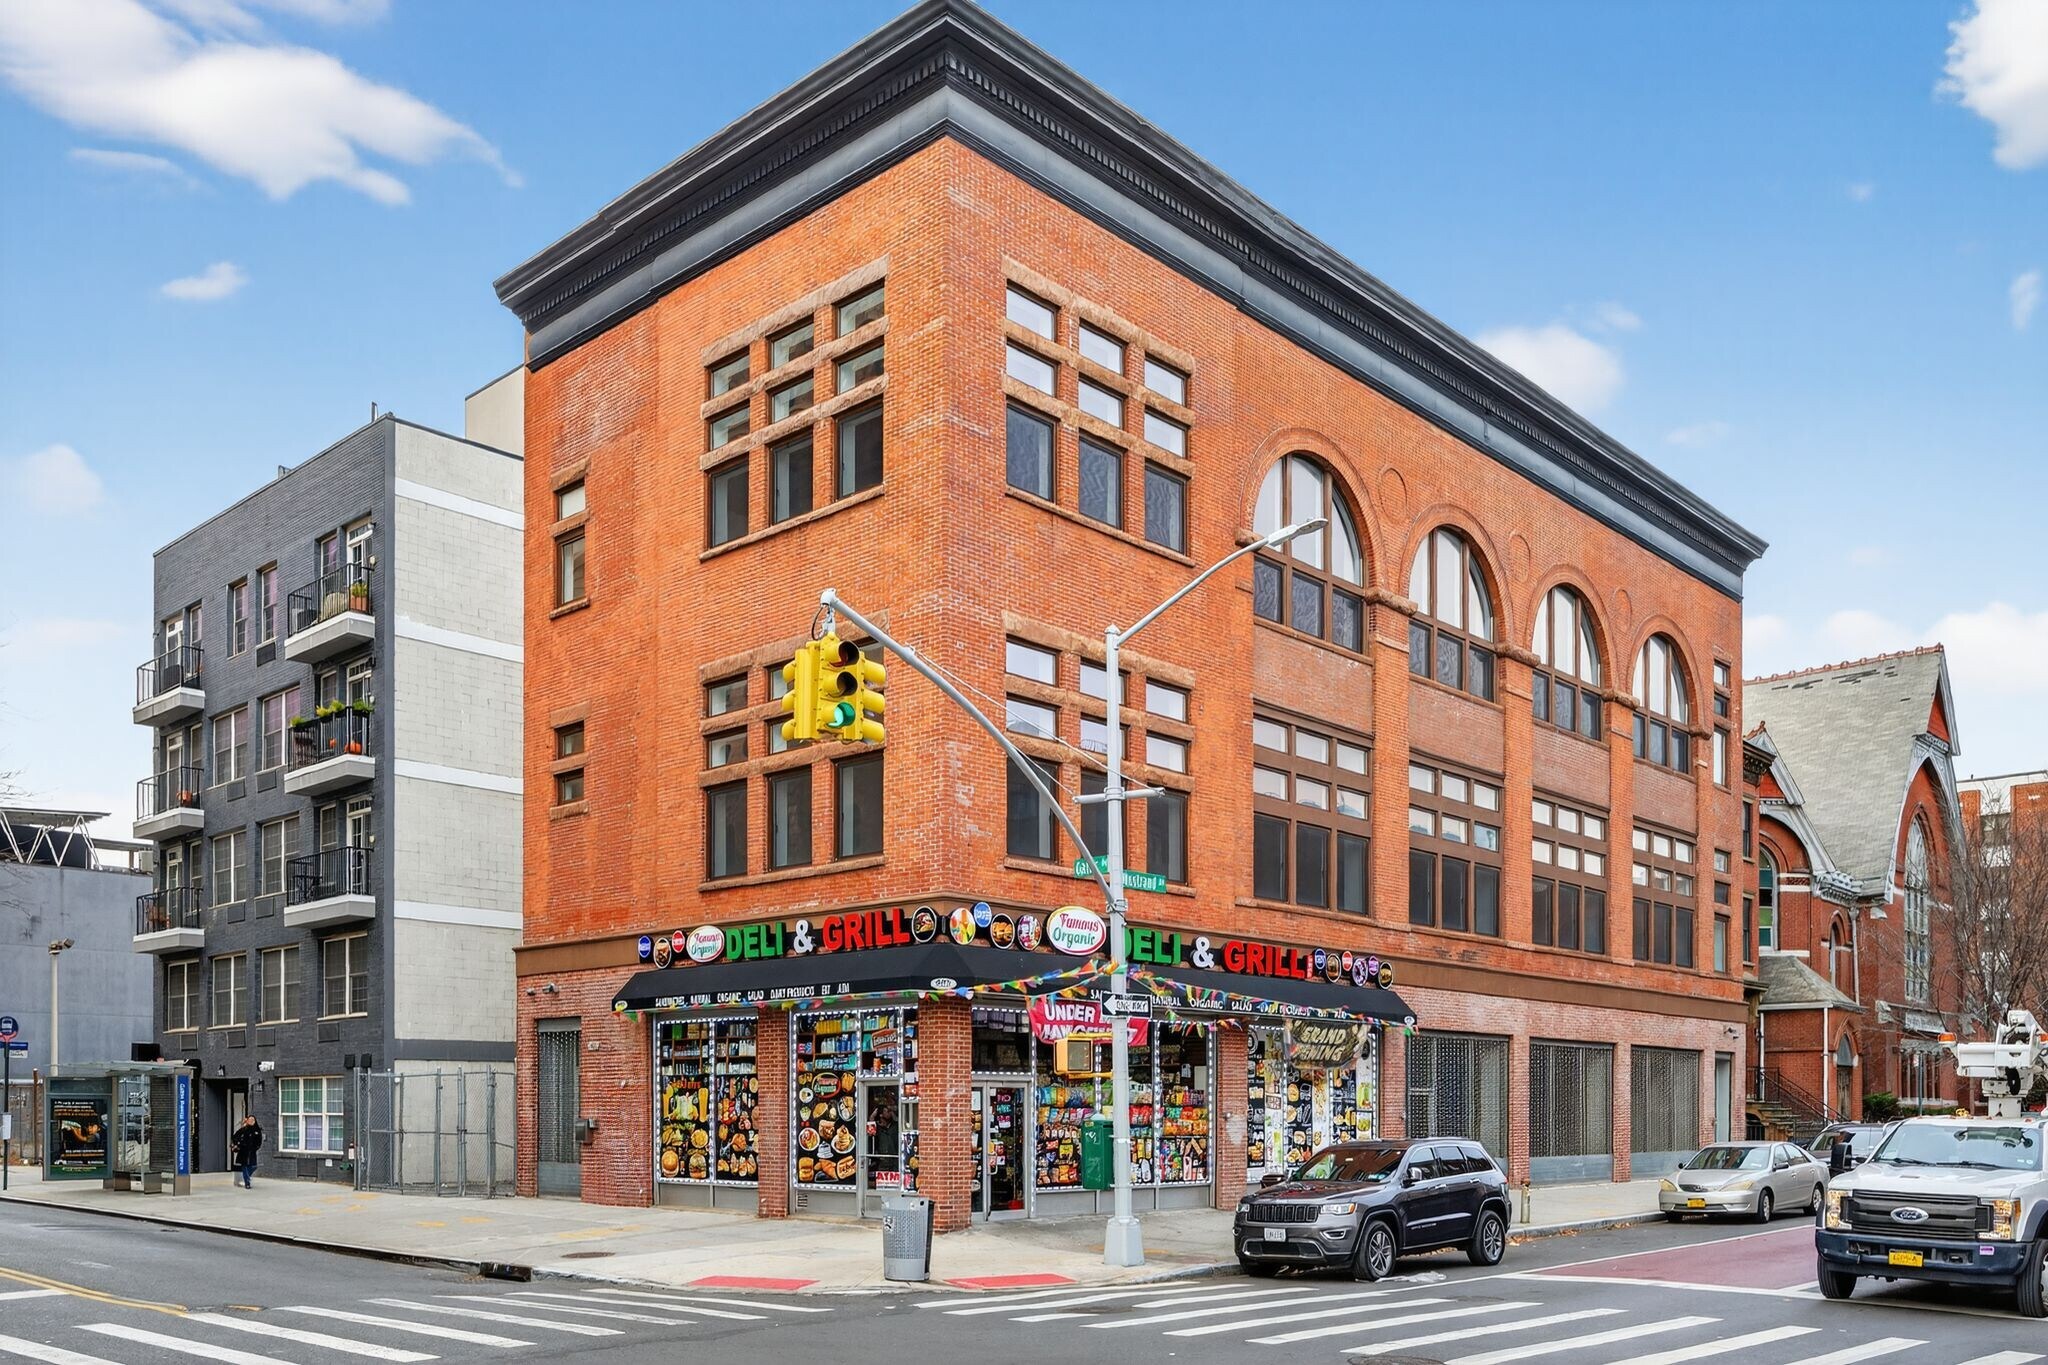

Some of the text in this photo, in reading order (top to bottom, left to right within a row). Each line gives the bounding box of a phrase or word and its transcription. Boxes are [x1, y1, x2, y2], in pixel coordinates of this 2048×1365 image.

[725, 906, 911, 961] DELI & GRILL
[1192, 935, 1215, 969] &
[1223, 939, 1305, 979] GRILL
[1043, 1003, 1096, 1023] UNDER
[1301, 1026, 1346, 1044] GRAND
